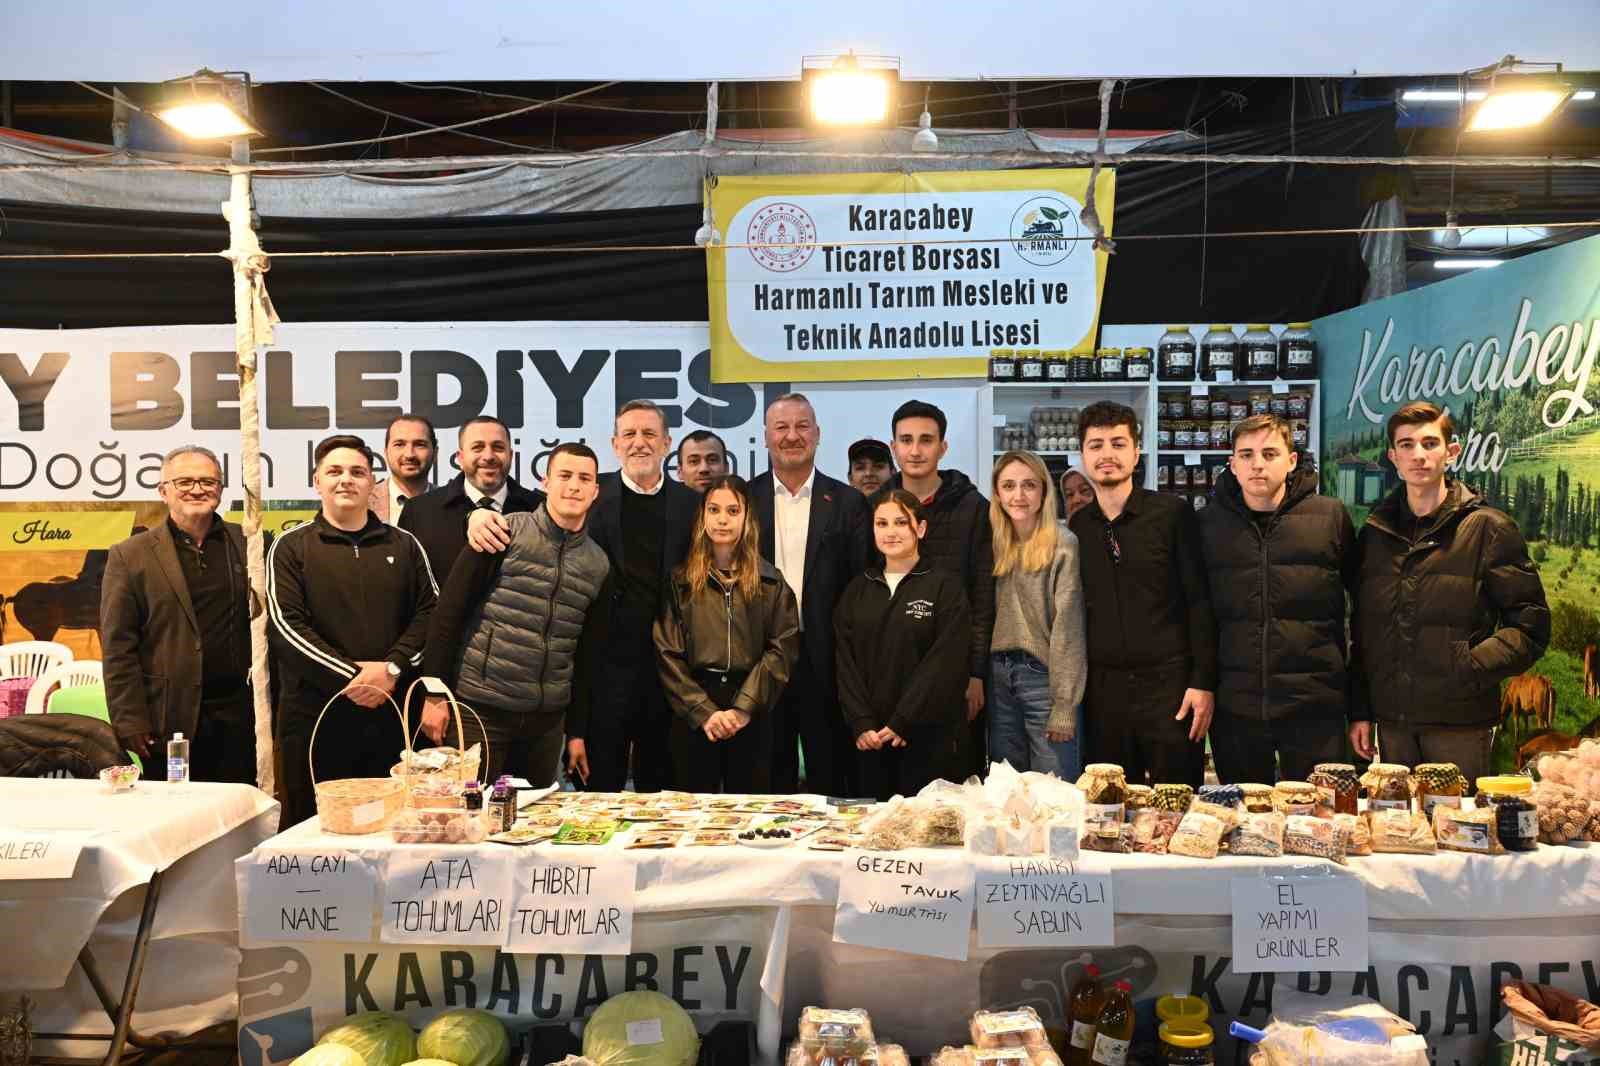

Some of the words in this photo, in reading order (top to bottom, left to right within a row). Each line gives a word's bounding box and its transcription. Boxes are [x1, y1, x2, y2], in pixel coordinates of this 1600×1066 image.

[849, 203, 974, 232] Karacabey
[822, 245, 905, 273] Ticaret
[912, 245, 1000, 272] Borsası
[754, 281, 861, 311] Harmanlı
[869, 281, 936, 308] Tarım
[942, 277, 1035, 307] Mesleki
[1042, 281, 1068, 304] ve
[784, 322, 861, 351] Teknik
[868, 320, 964, 349] Anadolu
[971, 319, 1040, 347] Lisesi
[1347, 298, 1600, 428] Karacabey
[12, 520, 72, 544] Hara
[266, 855, 301, 875] ADA
[311, 855, 348, 876] ÇAYI
[420, 858, 476, 890] ATA
[856, 855, 923, 876] GEZEN
[900, 884, 962, 902] TAVUK
[1277, 884, 1304, 907] EL
[281, 906, 341, 931] NANE
[391, 899, 502, 933] TOHUMLARI
[518, 907, 621, 936] TOHUMLAR
[1014, 910, 1083, 935] SABUN
[1257, 910, 1318, 931] YAPIMI
[1256, 936, 1340, 960] ÜRÜNLER
[343, 945, 752, 1019] KARACABEY
